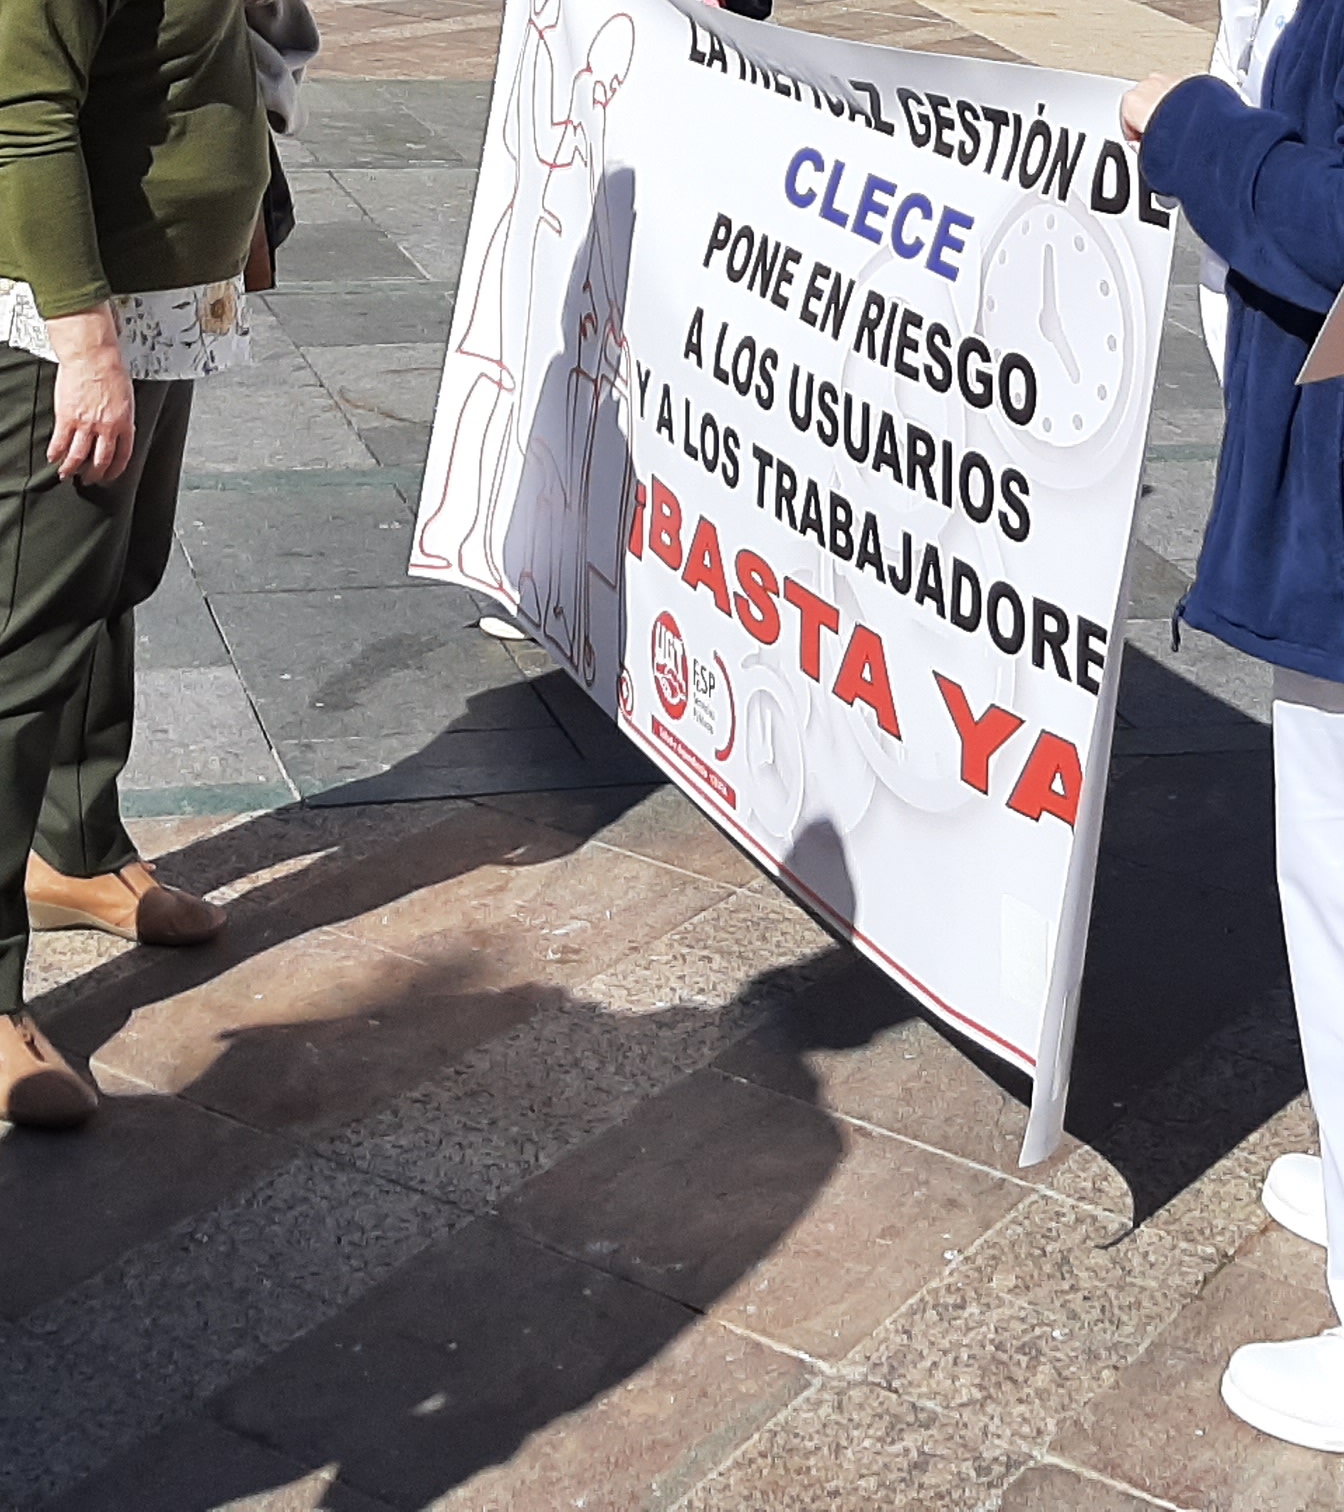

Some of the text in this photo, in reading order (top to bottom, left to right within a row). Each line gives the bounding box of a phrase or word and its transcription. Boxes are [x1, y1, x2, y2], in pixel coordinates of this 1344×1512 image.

[689, 16, 728, 75] LA
[896, 87, 1086, 203] GESTIÓN
[785, 147, 975, 282] CLECE
[703, 211, 1038, 426] PONE EN RIESGO
[635, 359, 651, 420] Y
[655, 383, 675, 445] A
[683, 397, 740, 489] LOS
[683, 306, 1031, 543] A LOS USUARIOS
